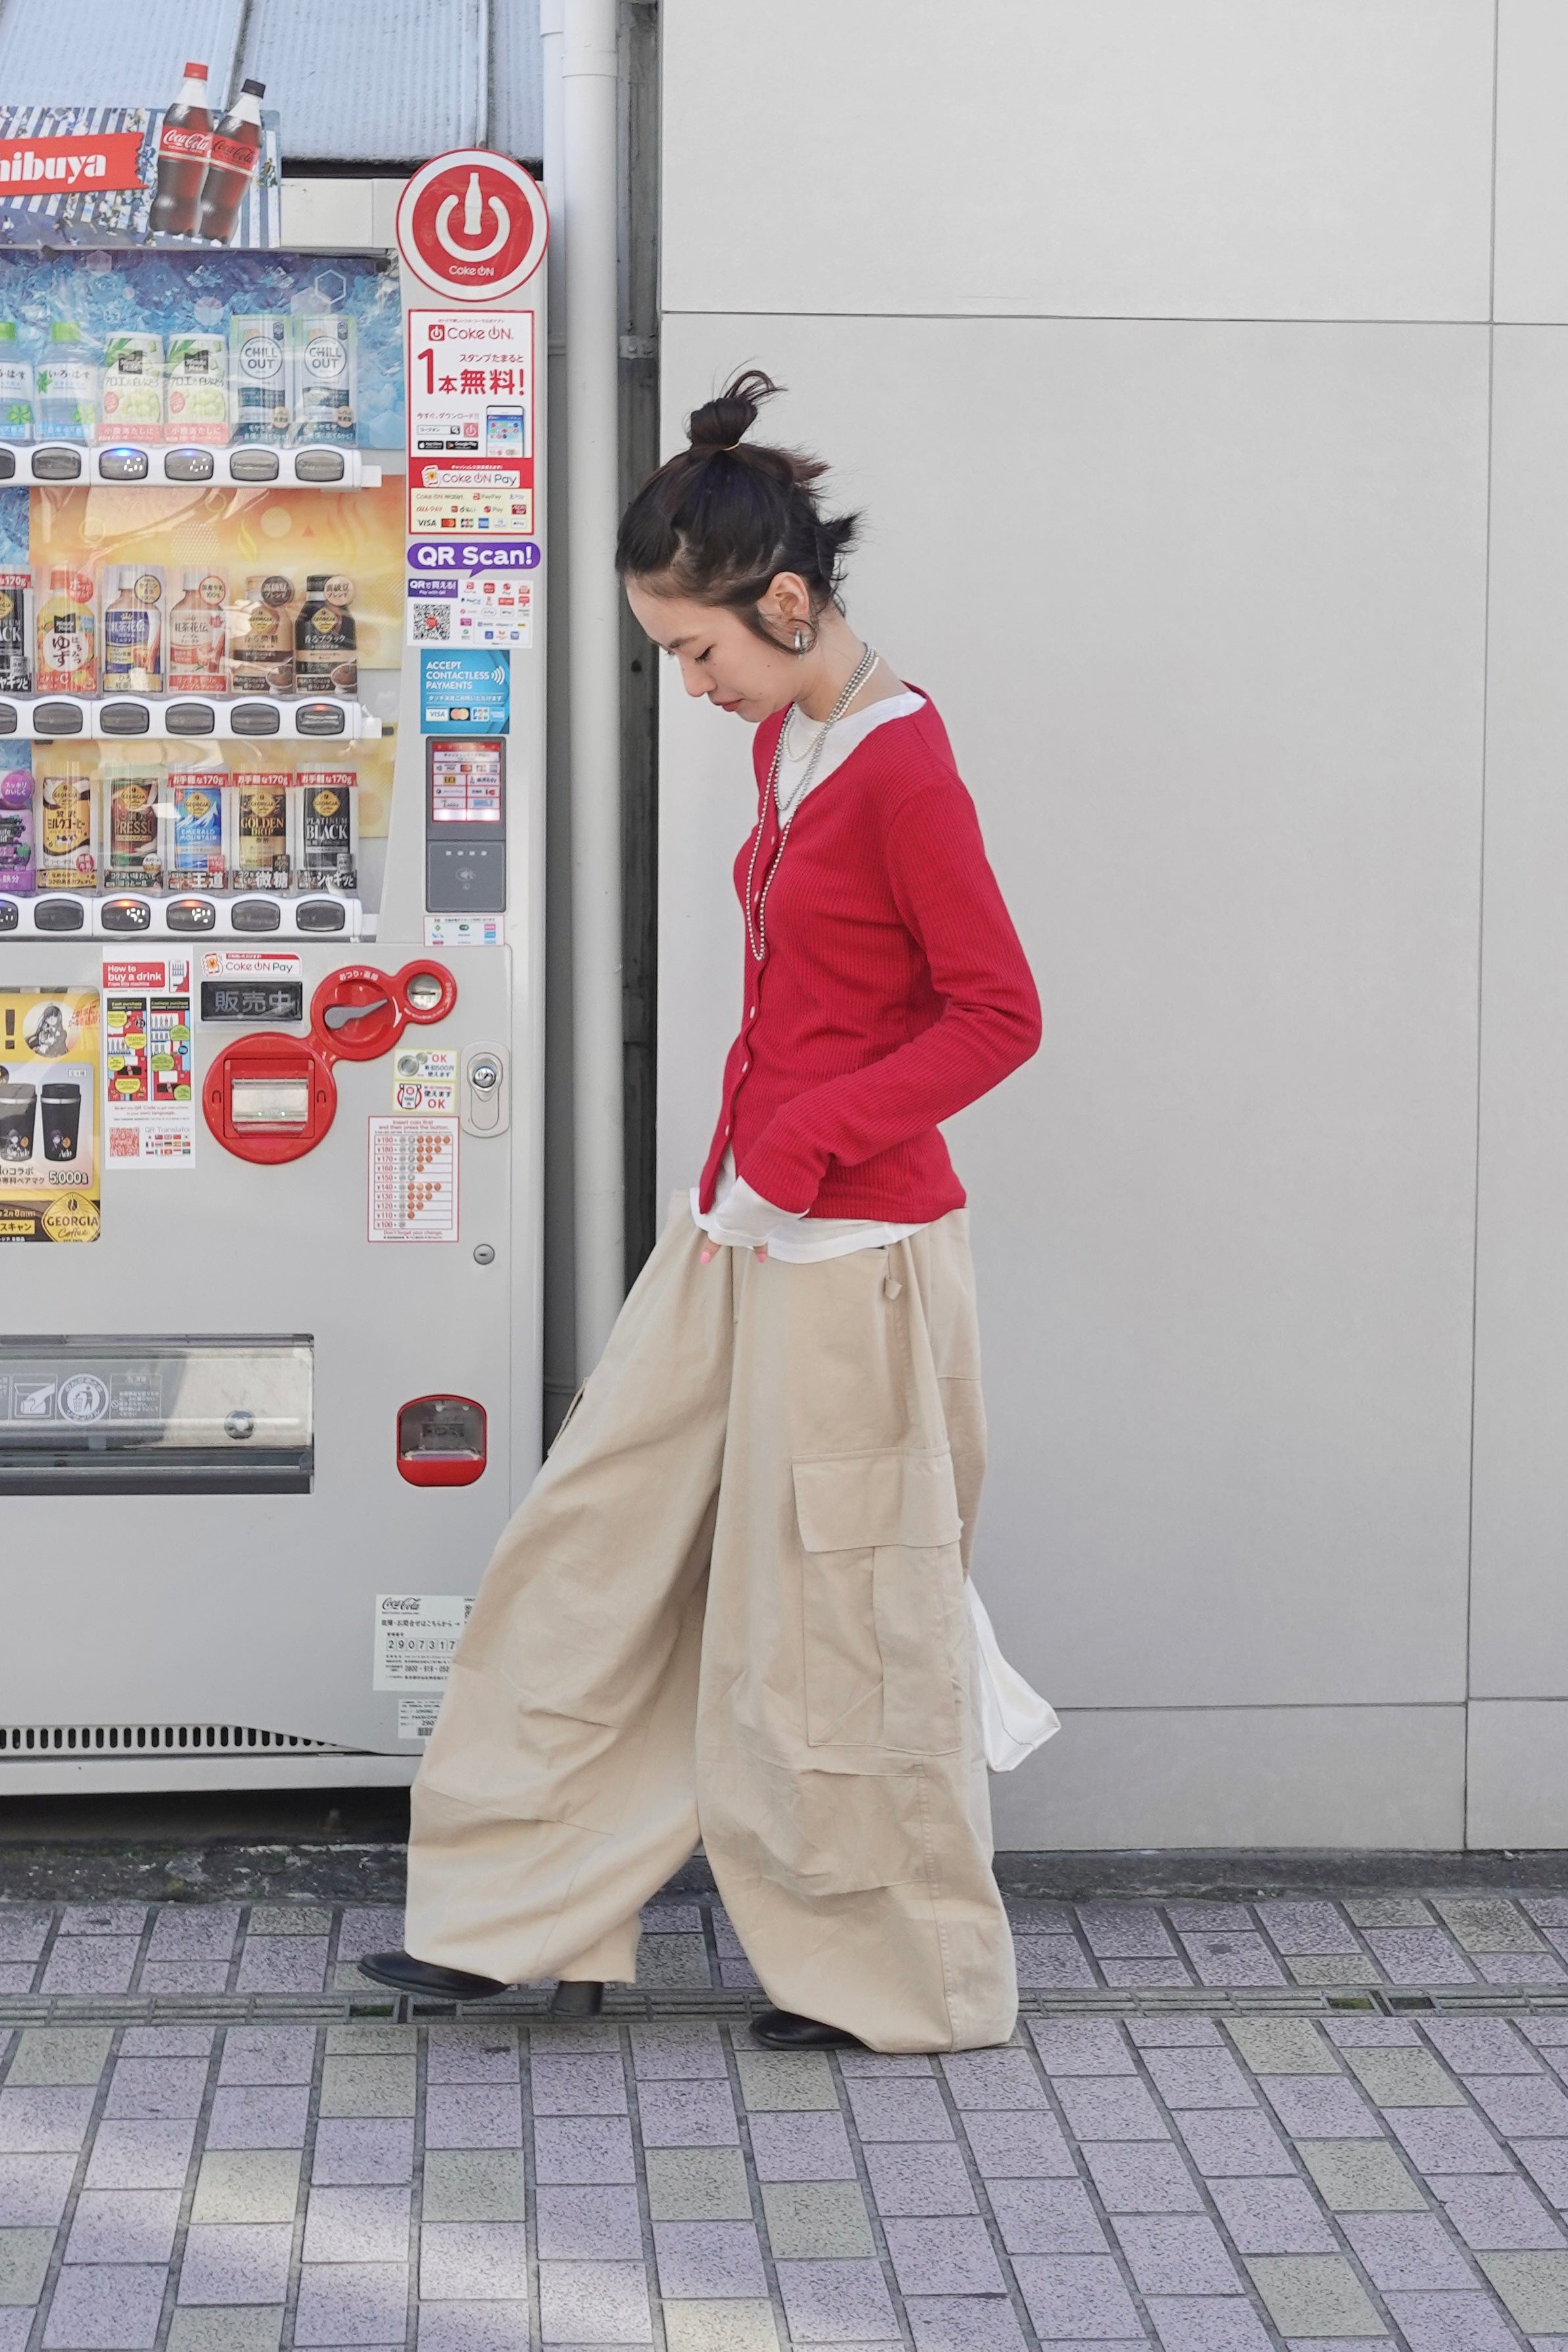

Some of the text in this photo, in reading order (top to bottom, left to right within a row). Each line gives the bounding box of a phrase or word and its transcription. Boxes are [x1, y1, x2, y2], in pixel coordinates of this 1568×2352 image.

[449, 266, 494, 276] Coke ON
[447, 327, 511, 340] Coke ON
[245, 348, 278, 358] CHILL
[309, 348, 342, 358] CHILL
[248, 359, 273, 369] OUT
[312, 359, 336, 369] OUT
[442, 473, 517, 486] Coke ON Pay
[417, 546, 532, 567] QR Scan!
[110, 620, 145, 632] 紅茶花伝
[175, 622, 208, 633] 紅茶花伝
[52, 635, 70, 667] ゆず
[426, 661, 461, 669] ACCEPT
[173, 776, 224, 785] お手軽な170g
[238, 776, 288, 785] お手軽な170g
[301, 775, 352, 784] お手軽な170g
[48, 820, 85, 829] ミルクコーヒー
[241, 818, 284, 828] GOLDEN
[307, 825, 347, 839] BLACK
[191, 871, 224, 888] 王道
[256, 871, 288, 888] 微糖
[318, 871, 355, 887] シャキッと
[225, 961, 292, 974] Coke ON Pay
[108, 973, 127, 982] buy
[136, 972, 162, 981] drink
[215, 990, 292, 1014] 販売中
[432, 1054, 447, 1063] OK
[428, 1099, 445, 1108] OK
[59, 1149, 72, 1159] Ado
[0, 1165, 33, 1176] oコラボ
[0, 1222, 32, 1231] スキャン
[47, 1216, 98, 1227] GEORGIA
[58, 1227, 88, 1239] Coffee
[382, 1597, 421, 1610] Coca-Cola
